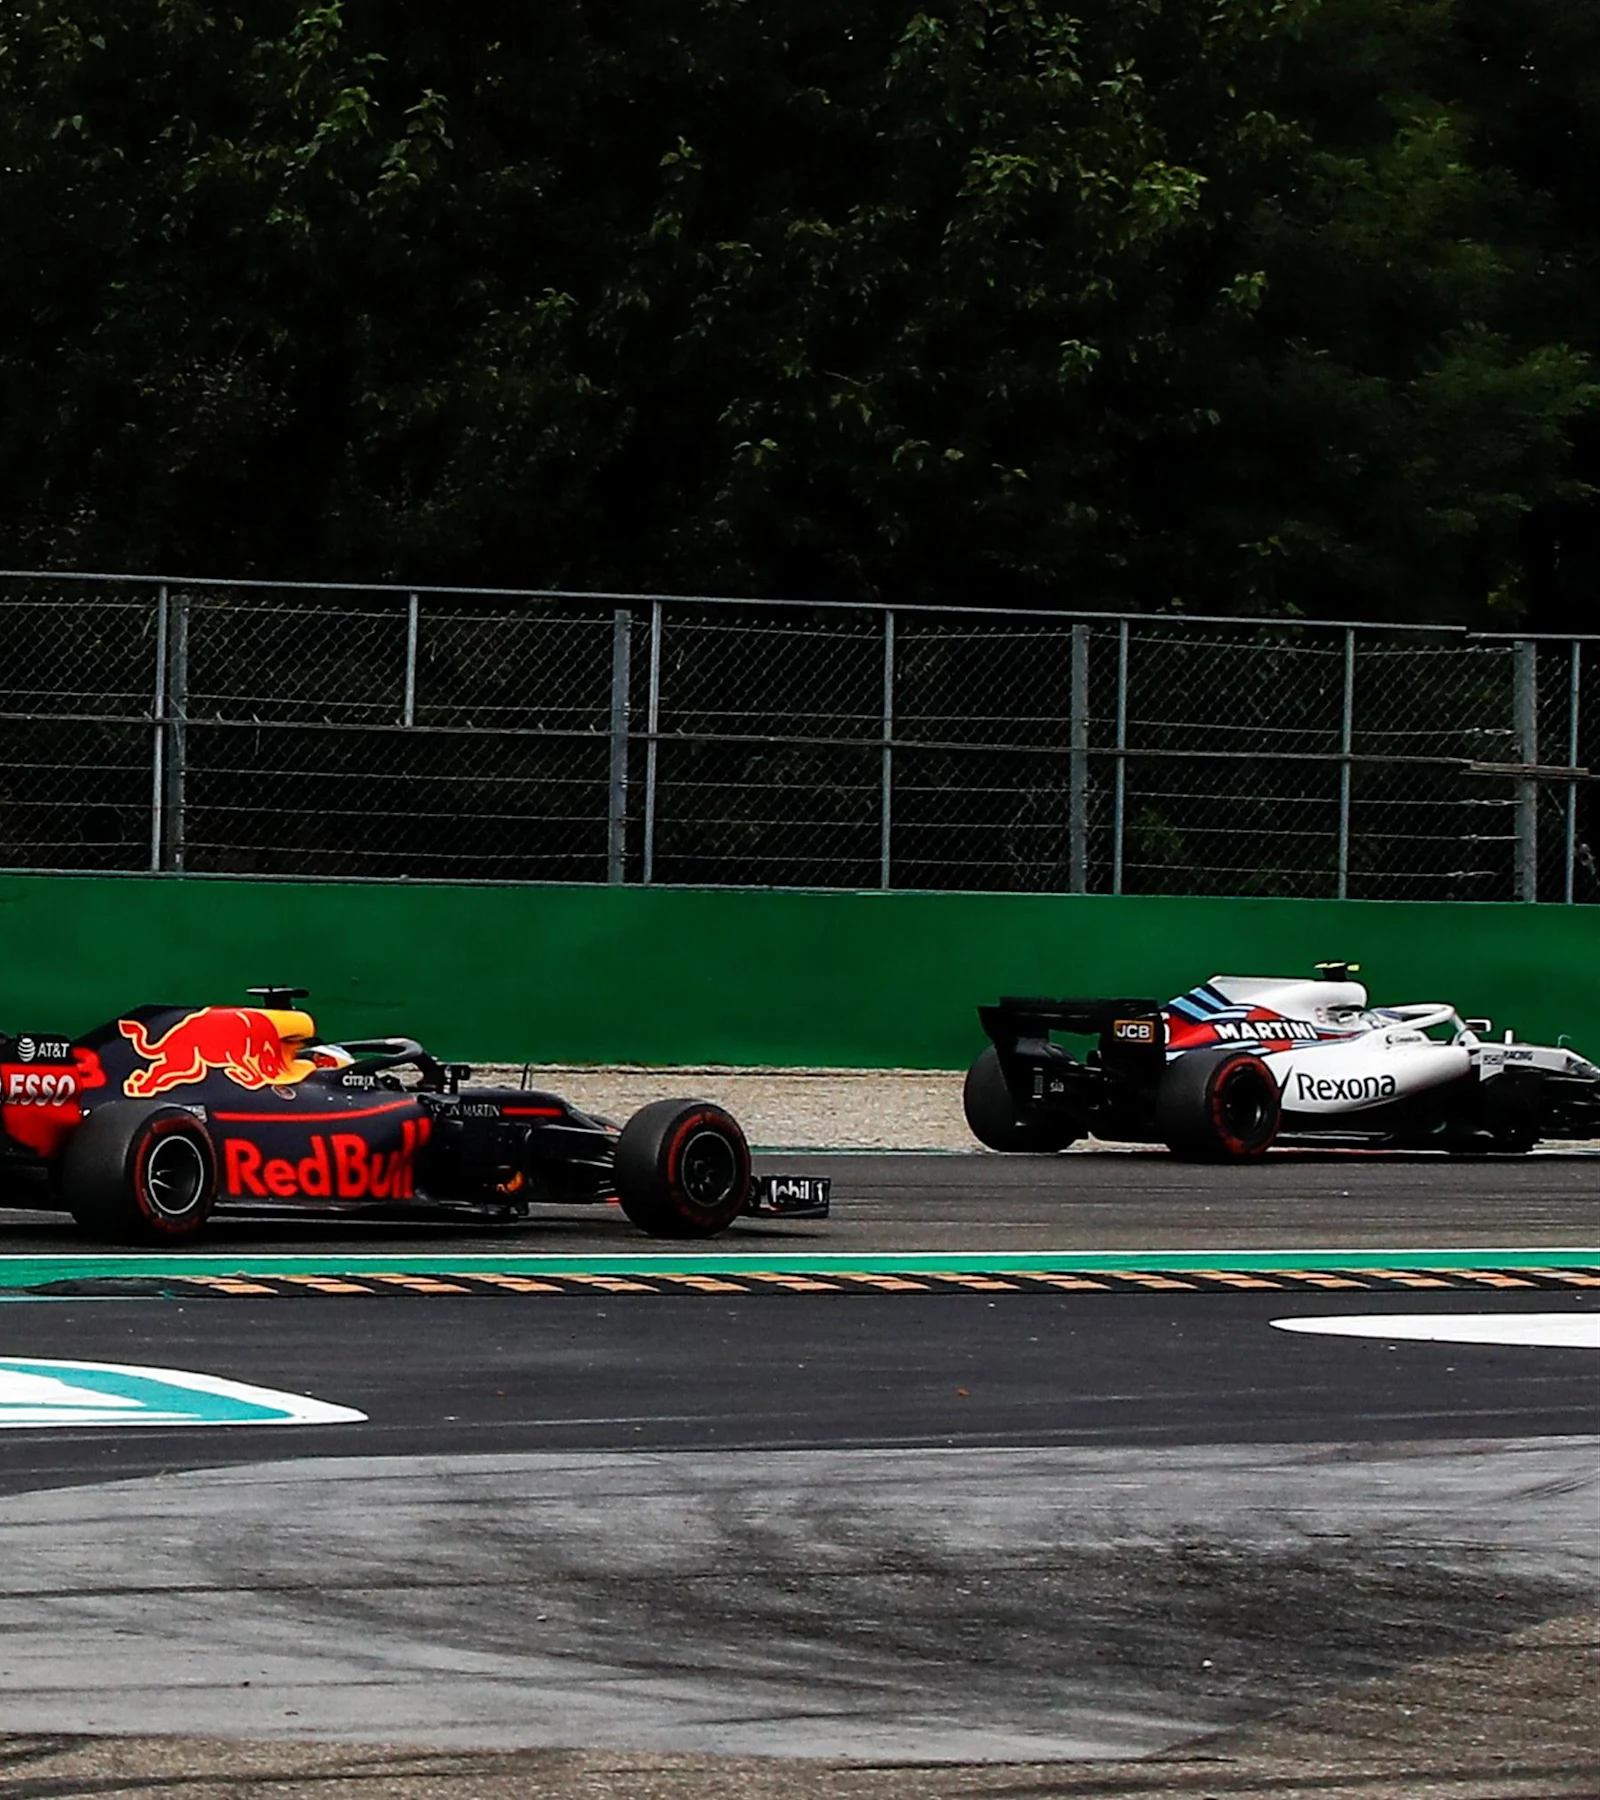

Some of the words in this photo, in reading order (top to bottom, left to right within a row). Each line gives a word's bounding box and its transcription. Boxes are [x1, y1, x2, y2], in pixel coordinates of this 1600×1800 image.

[1115, 1023, 1151, 1039] JCB
[1213, 1023, 1319, 1040] MARTINI
[37, 1042, 70, 1058] AT&T
[5, 1073, 76, 1107] ESSO
[1296, 1073, 1396, 1101] Rexona
